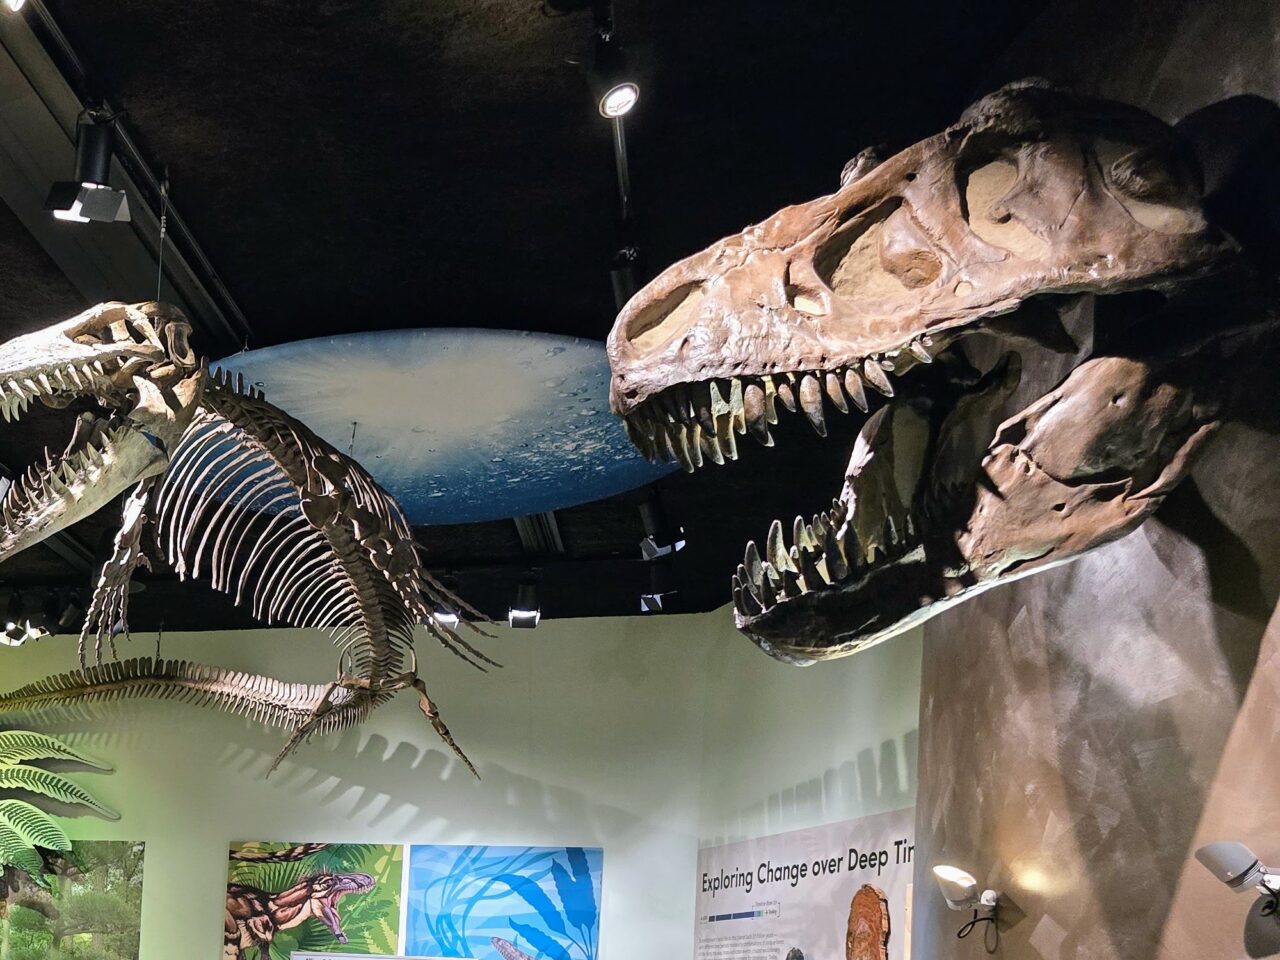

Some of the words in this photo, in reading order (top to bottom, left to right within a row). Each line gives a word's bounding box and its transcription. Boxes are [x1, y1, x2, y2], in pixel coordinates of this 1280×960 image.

[702, 867, 753, 898] Exploring
[757, 860, 808, 887] Change
[812, 856, 844, 877] over
[848, 848, 889, 876] Deep
